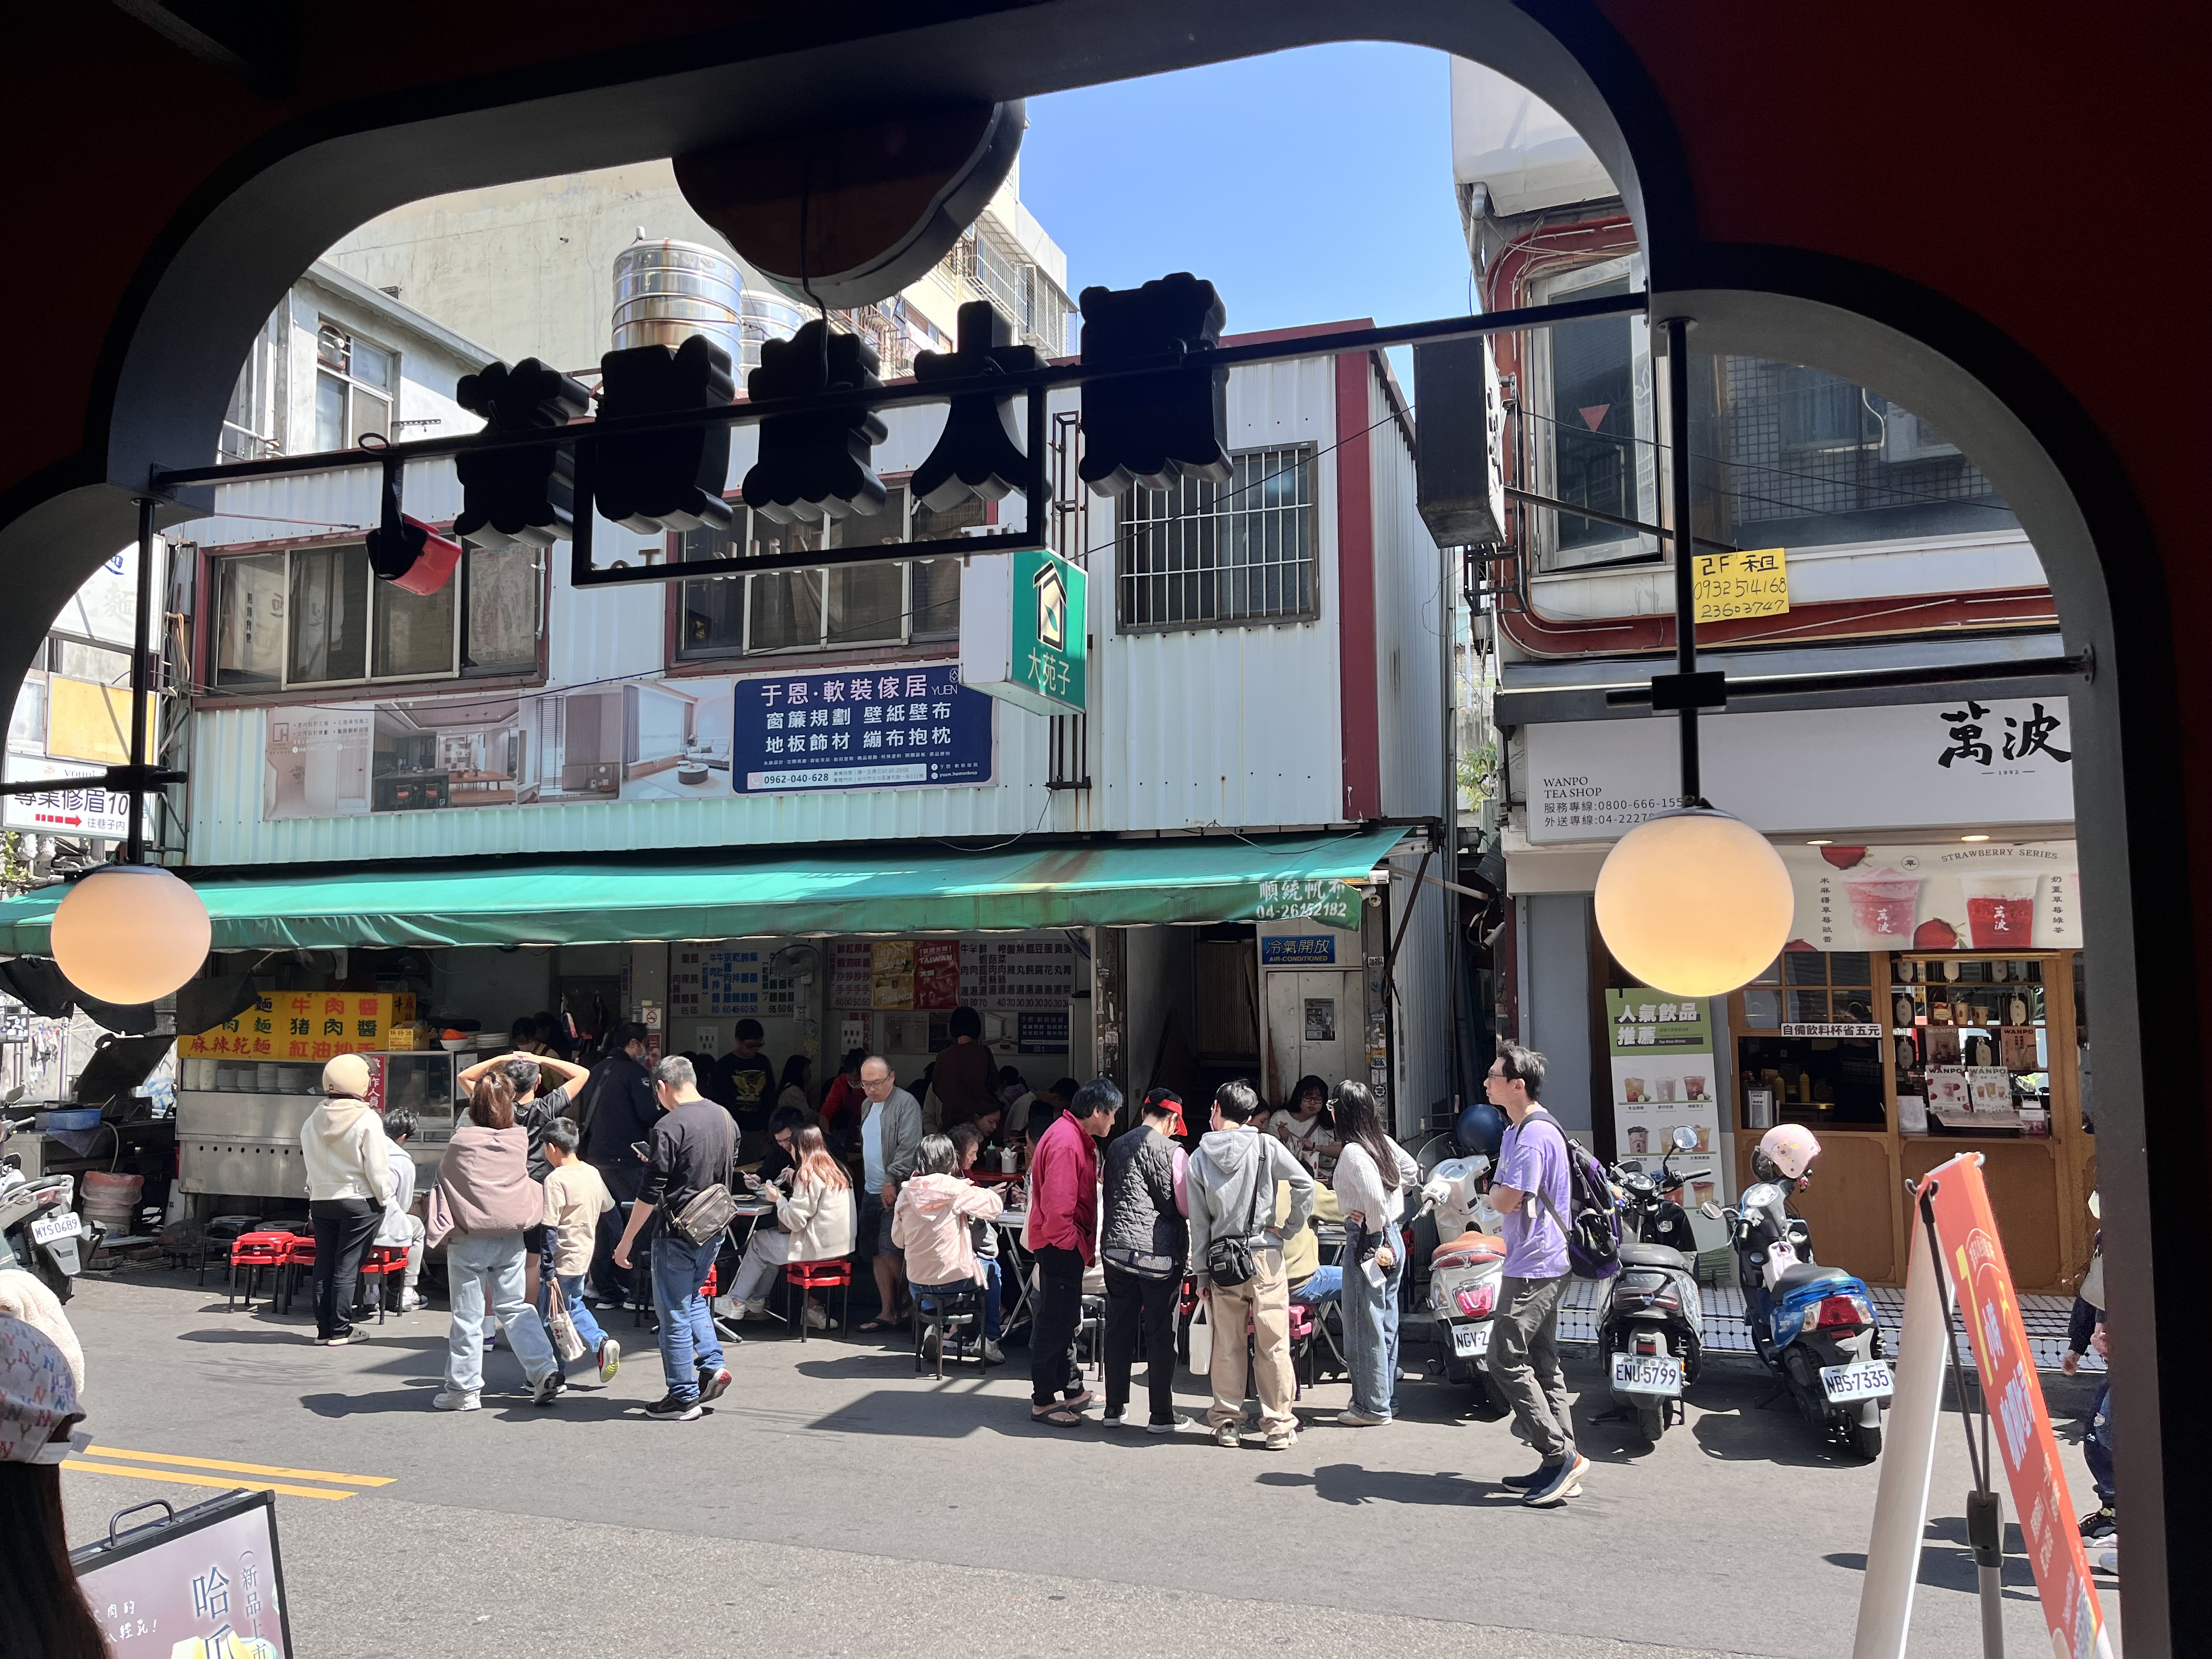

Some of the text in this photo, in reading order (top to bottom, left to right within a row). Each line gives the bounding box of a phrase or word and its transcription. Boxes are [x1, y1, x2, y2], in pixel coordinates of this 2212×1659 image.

[1701, 555, 1779, 576] 2F 租
[1694, 579, 1731, 600] 0932
[1701, 600, 1784, 618] 23603747
[1028, 647, 1070, 696] 大苑子
[931, 684, 958, 697] YUEN
[766, 702, 951, 730] 窗簾規劃 壁紙壁布
[765, 726, 951, 753] 地板飾材 繃布抱枕
[1938, 701, 2072, 768] 萬波
[764, 773, 828, 784] 0962-040-628
[1543, 776, 1588, 787] WANPO
[1544, 787, 1602, 799] TEA SHOP
[1941, 848, 2058, 862] STRAWBERRY SERIES
[1266, 939, 1330, 955] 冷氣開放
[919, 954, 952, 964] TAIWAN
[291, 997, 379, 1015] 牛肉醬
[1618, 1002, 1697, 1023] 人氣飲品
[1617, 1026, 1656, 1045] 推薦
[1782, 1024, 1881, 1037] 自備飲料杯省五元
[189, 1035, 271, 1054] 麻辣乾麵
